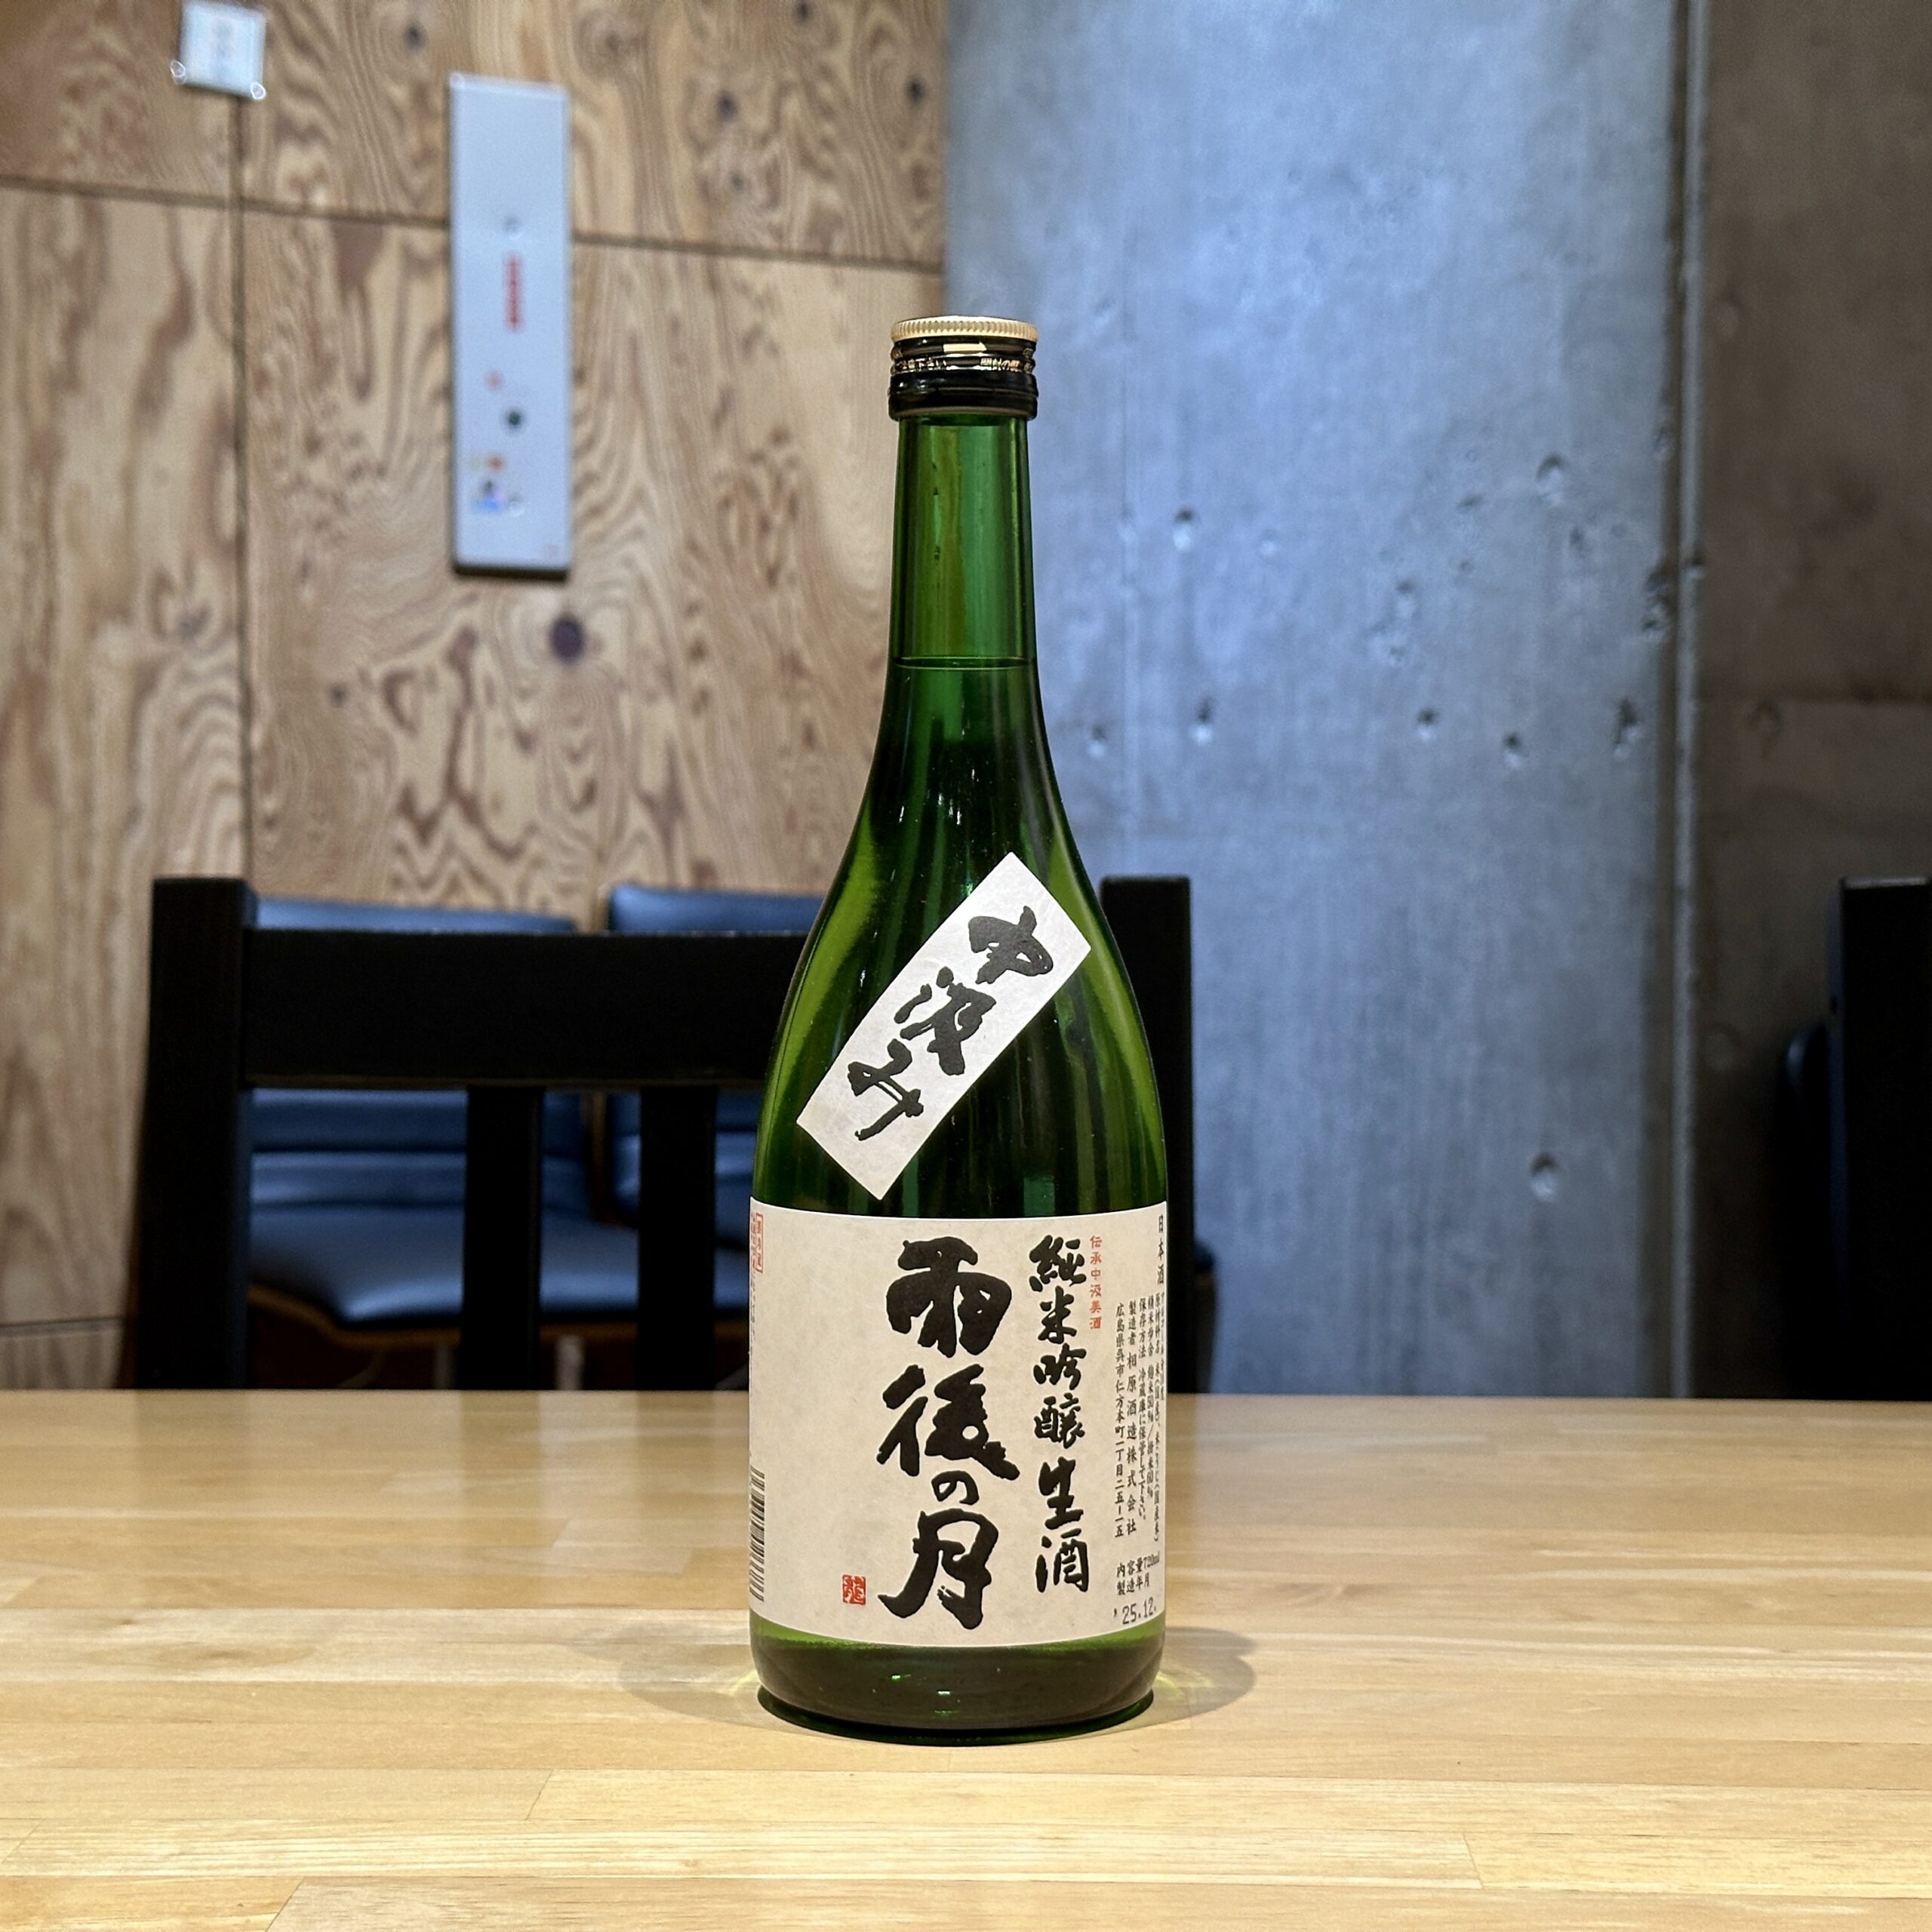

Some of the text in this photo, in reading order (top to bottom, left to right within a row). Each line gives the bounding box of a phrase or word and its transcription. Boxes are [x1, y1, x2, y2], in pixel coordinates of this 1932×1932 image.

[847, 906, 1054, 1141] 中汲み
[876, 1236, 1020, 1630] 雨後の月
[1029, 1235, 1089, 1593] 純米吟醸生酒
[1127, 1300, 1137, 1535] 製造者 相原酒造株式会社
[1116, 1572, 1149, 1595] 製造年月
